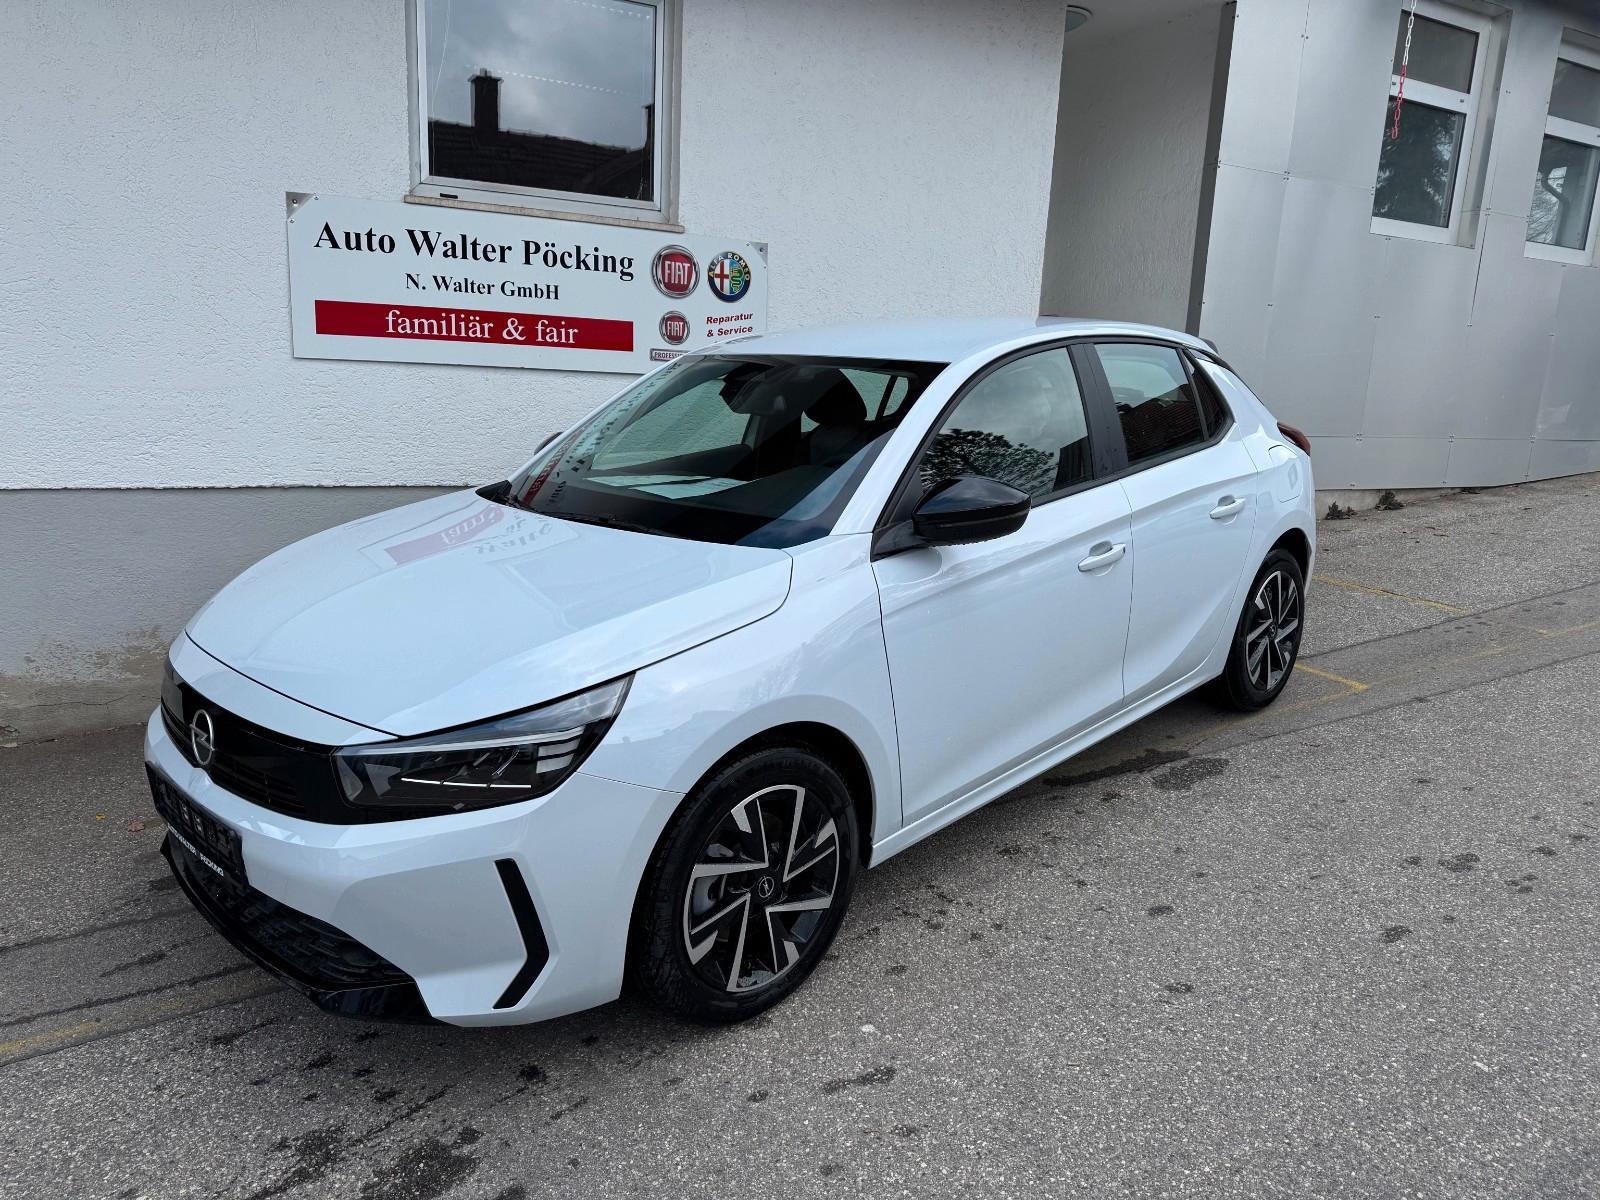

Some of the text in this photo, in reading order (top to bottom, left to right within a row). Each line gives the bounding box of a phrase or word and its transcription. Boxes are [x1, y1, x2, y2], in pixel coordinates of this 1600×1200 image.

[313, 221, 634, 282] Auto Walter Pöcking
[664, 260, 691, 285] FIAT
[708, 252, 750, 280] ALFA ROMEO
[405, 272, 560, 301] N. Walter GmbH
[385, 309, 579, 344] familiär & fair
[667, 320, 684, 337] FIAT
[706, 312, 753, 325] Reparatur
[706, 326, 753, 338] & Service
